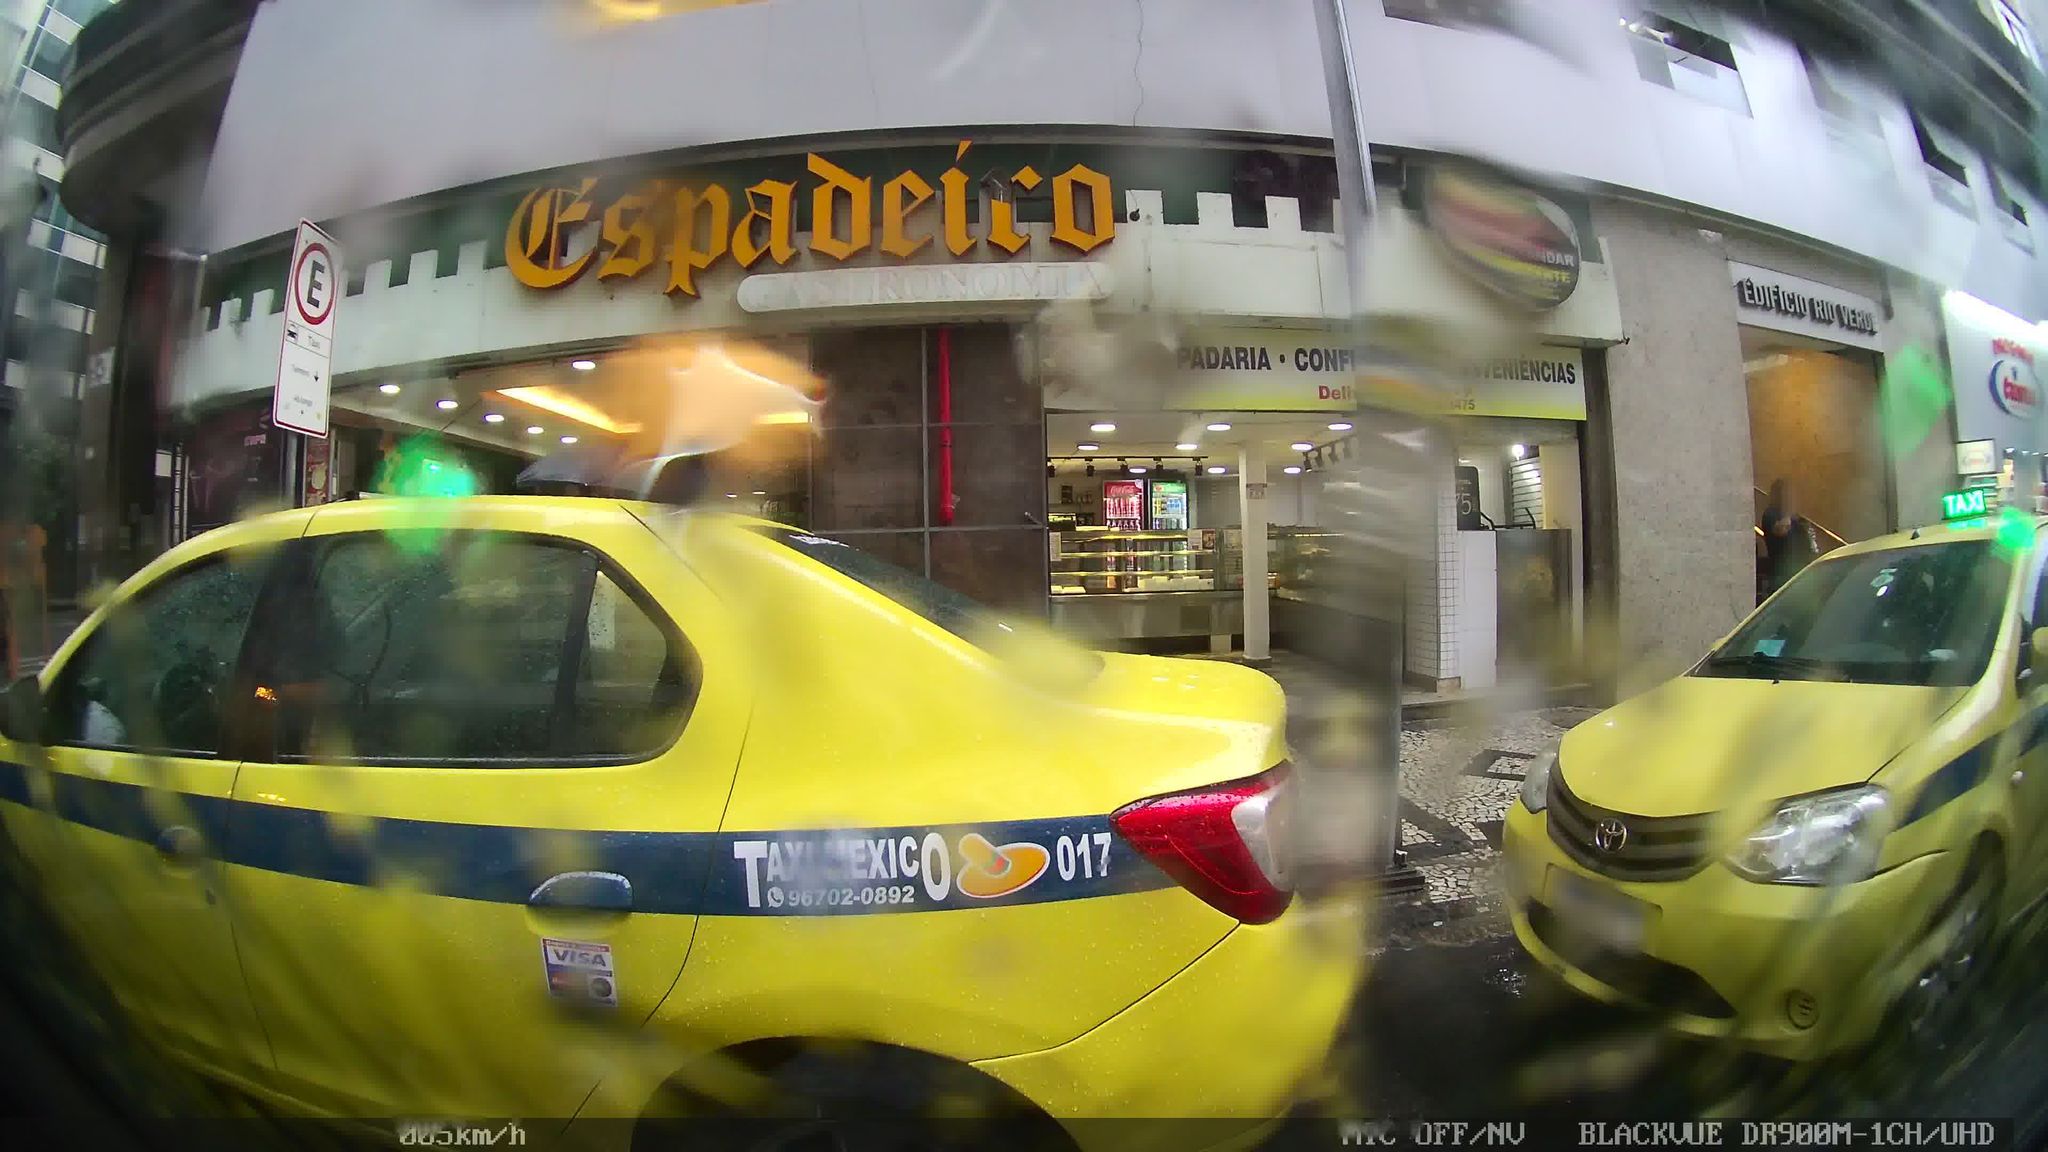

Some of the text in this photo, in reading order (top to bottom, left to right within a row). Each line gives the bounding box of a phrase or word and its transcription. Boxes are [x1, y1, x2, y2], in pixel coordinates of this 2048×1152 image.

[505, 140, 1115, 298] Espadeiro
[306, 260, 325, 309] E
[1177, 347, 1272, 371] PADARIA
[1943, 490, 1984, 515] TAXI
[1057, 832, 1112, 882] 017
[788, 884, 915, 907] 96702-0892
[553, 949, 607, 967] VISA
